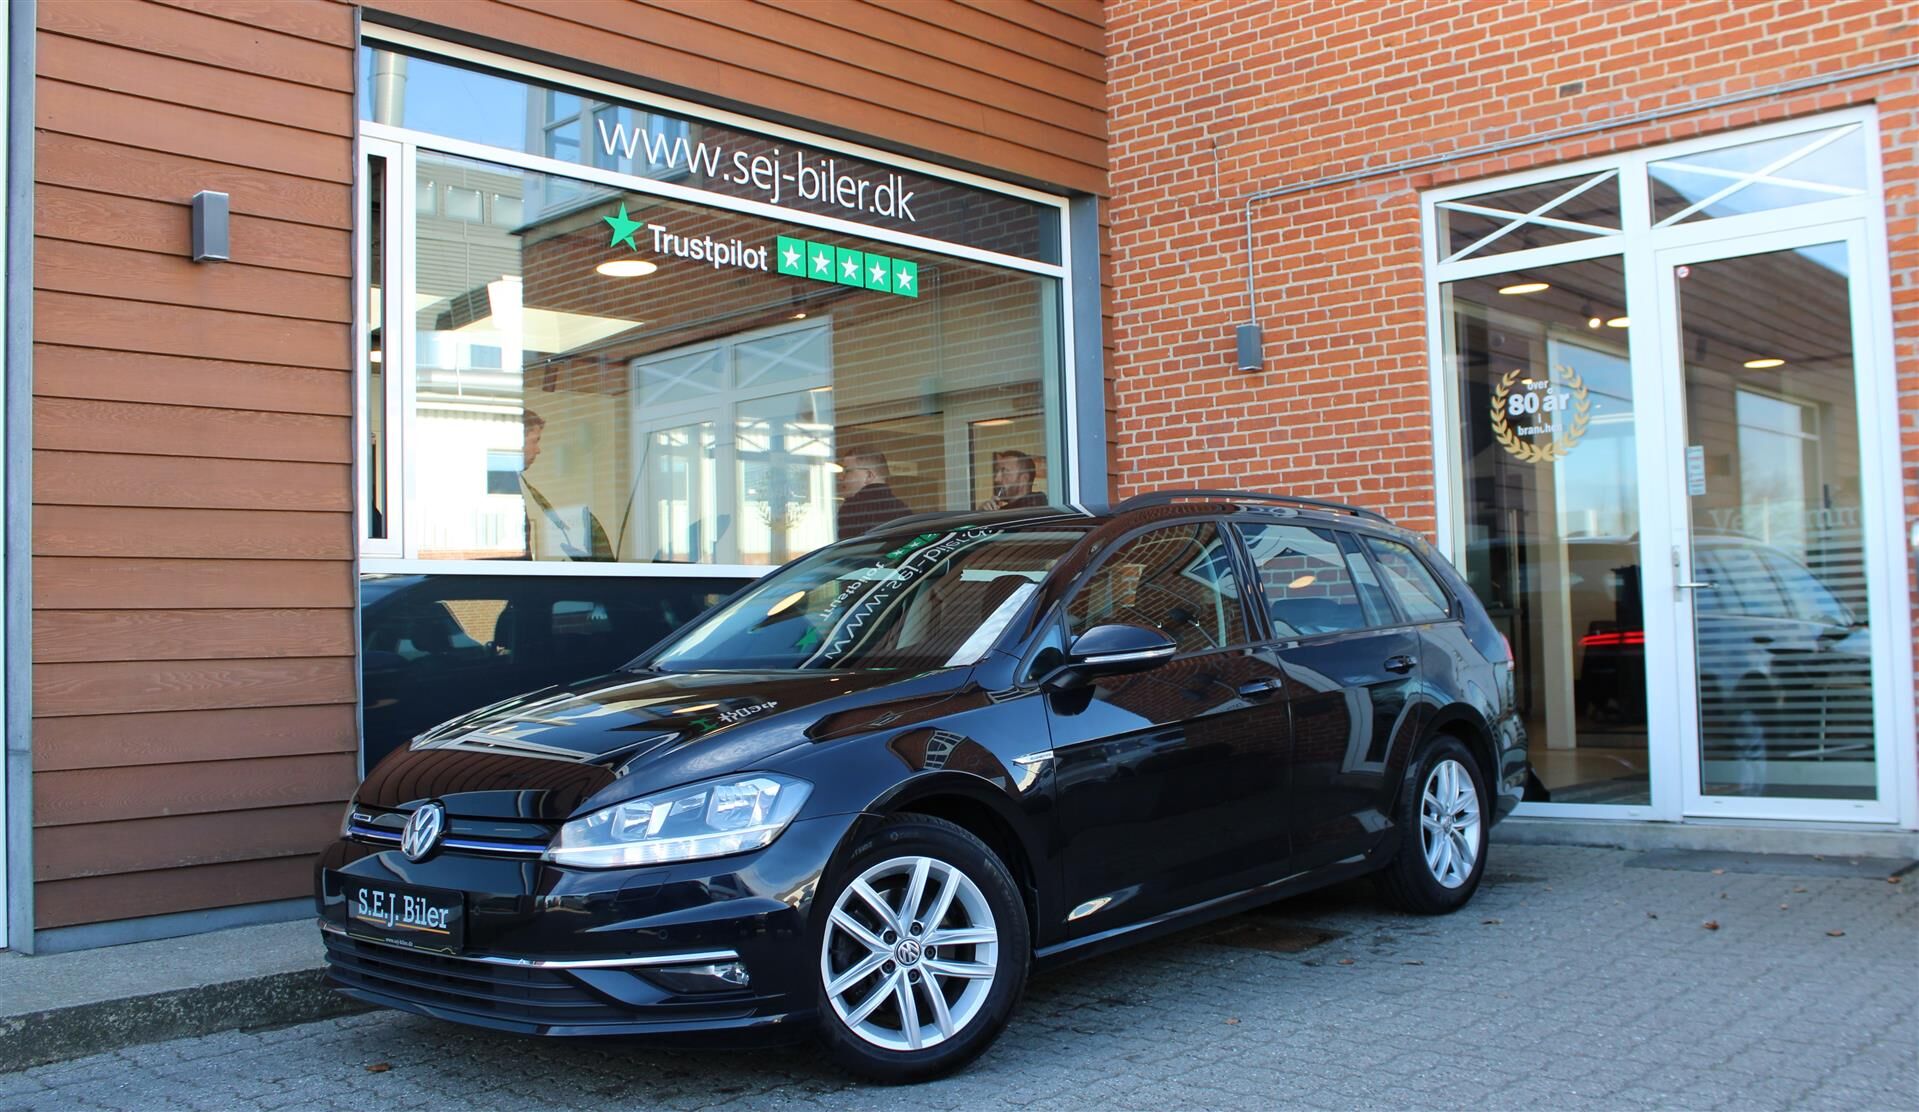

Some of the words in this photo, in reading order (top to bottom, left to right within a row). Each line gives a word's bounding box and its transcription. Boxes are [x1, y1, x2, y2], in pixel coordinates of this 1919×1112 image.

[598, 118, 916, 222] www.sej-biler.dk
[648, 223, 768, 272] Trustpilot
[1508, 392, 1540, 416] 80
[1543, 388, 1570, 411] år
[358, 887, 399, 928] S.E.J.
[403, 895, 449, 929] Biler
